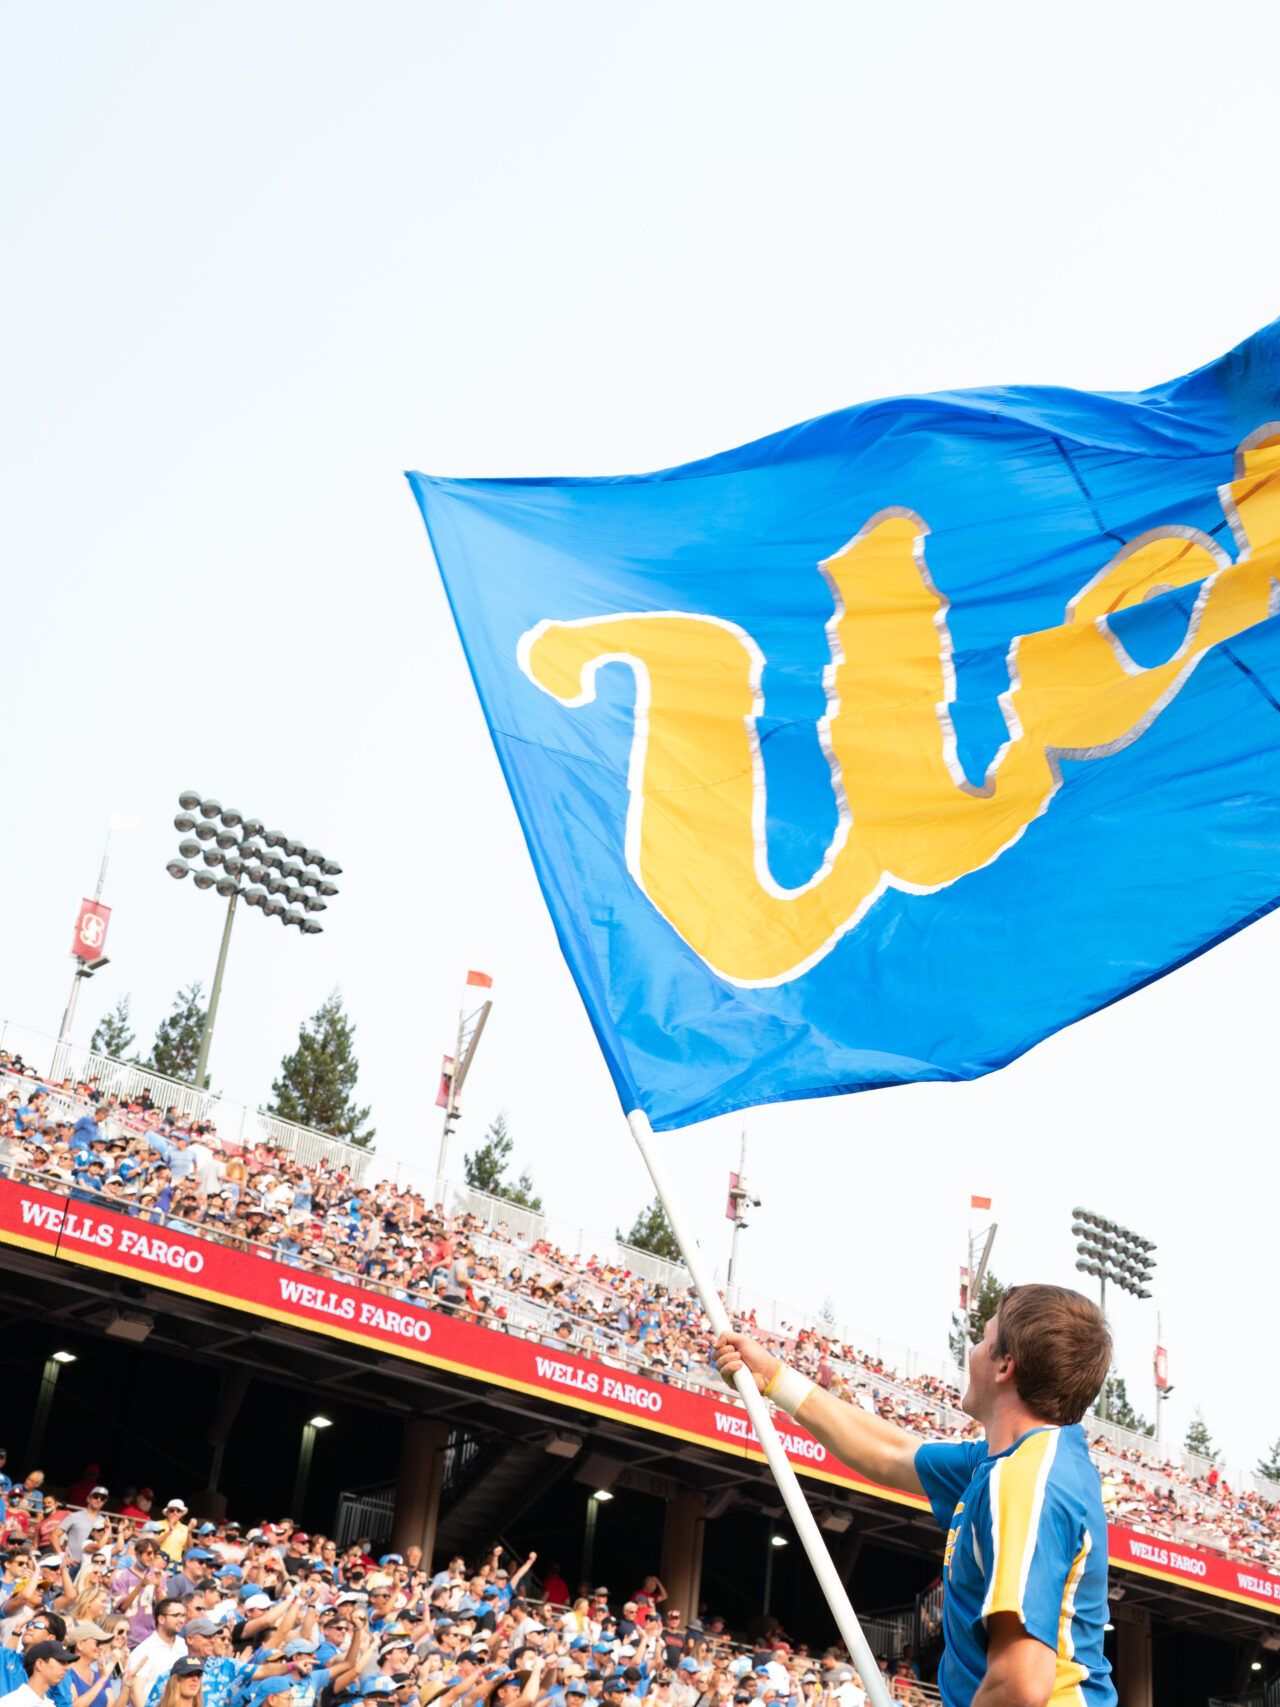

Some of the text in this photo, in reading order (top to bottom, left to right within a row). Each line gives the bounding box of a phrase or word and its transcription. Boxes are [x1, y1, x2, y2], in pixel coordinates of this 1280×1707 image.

[20, 1199, 204, 1273] WELLS FARGO
[279, 1278, 431, 1341] WELLS FARGO
[535, 1356, 662, 1411] WELLS FARGO
[714, 1411, 762, 1443] WELL
[1129, 1539, 1207, 1576] WELLS FARGO
[1237, 1572, 1272, 1596] WELLS
